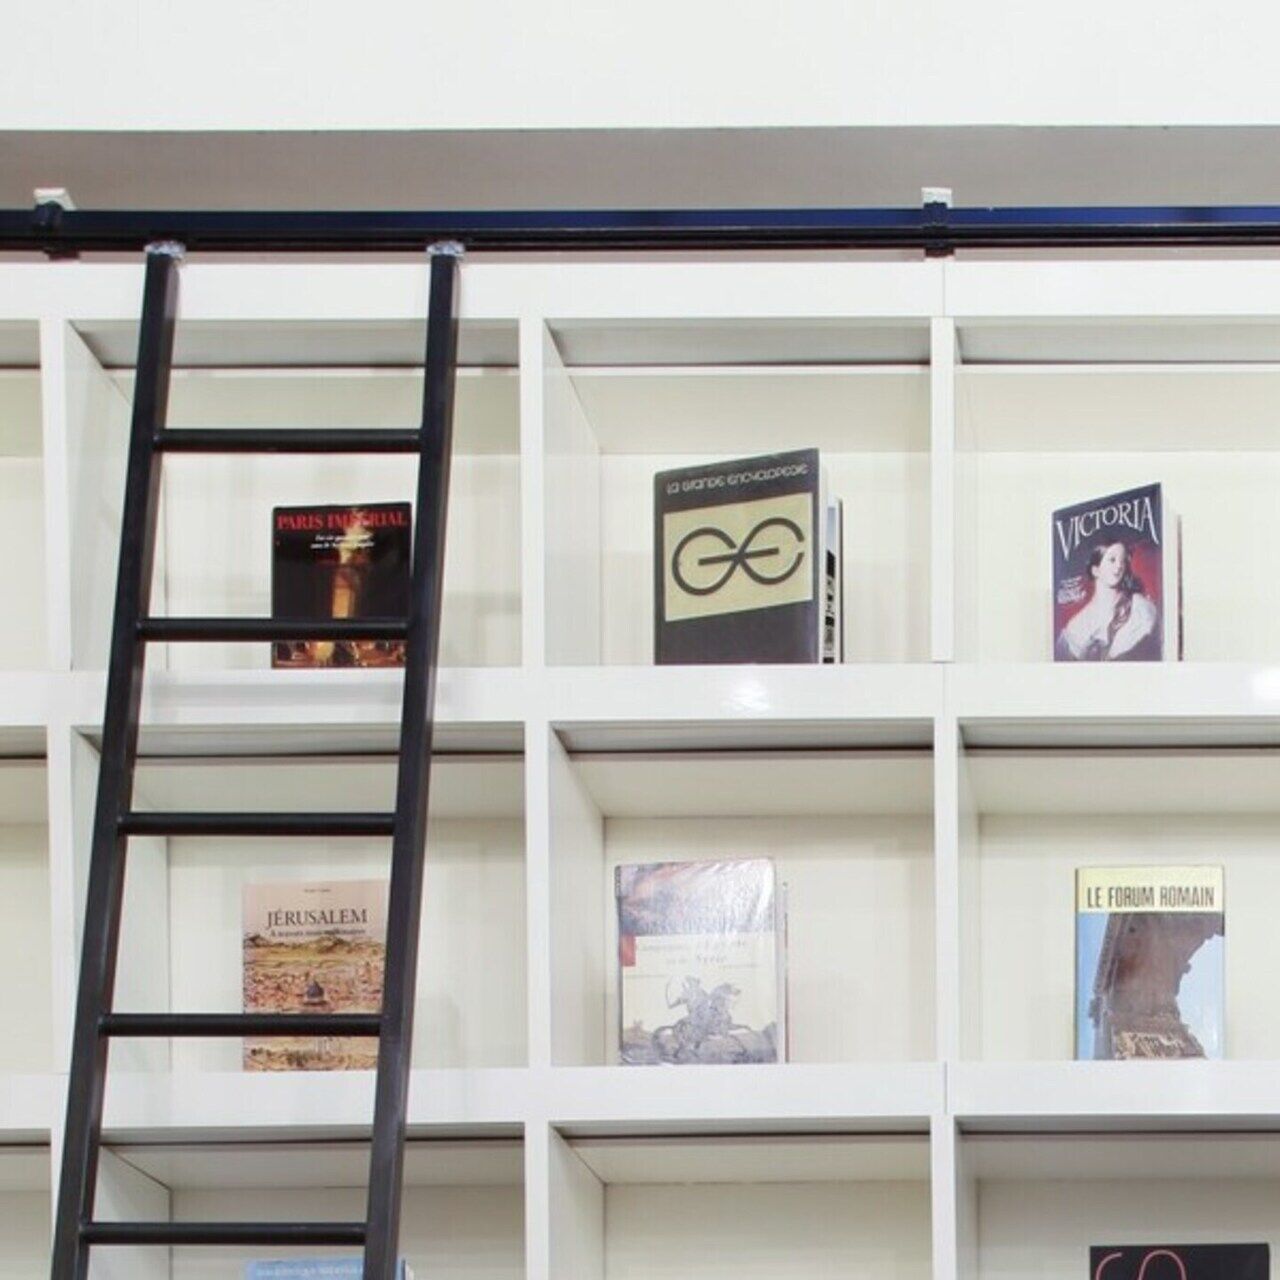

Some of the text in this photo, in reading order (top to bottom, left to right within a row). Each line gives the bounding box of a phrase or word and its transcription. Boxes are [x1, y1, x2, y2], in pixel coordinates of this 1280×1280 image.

[277, 513, 323, 530] PARIS
[1056, 497, 1160, 561] VICTORIA
[1087, 886, 1215, 908] LE FORUM ROMAIN
[266, 907, 368, 929] JÉRUSALEM
